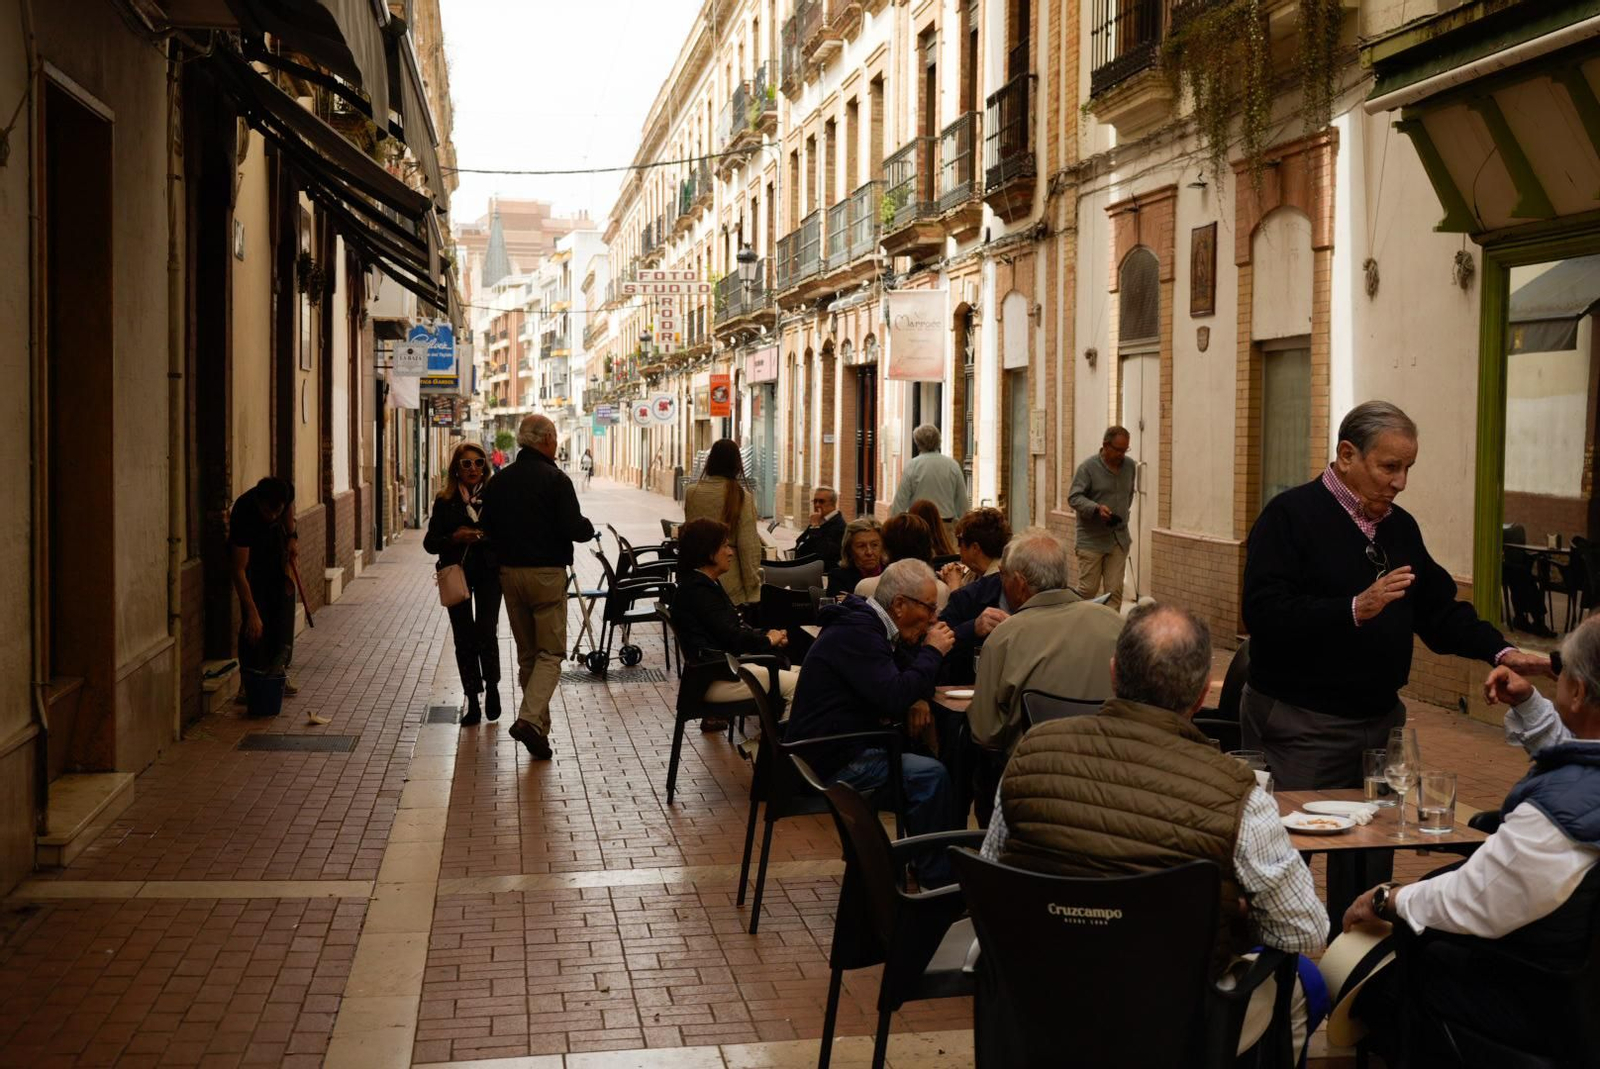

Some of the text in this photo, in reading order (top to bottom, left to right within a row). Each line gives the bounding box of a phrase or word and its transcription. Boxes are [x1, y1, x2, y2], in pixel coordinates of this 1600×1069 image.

[639, 271, 695, 280] FOTO
[624, 284, 710, 293] STUDIO
[661, 297, 673, 353] RODRI
[1047, 902, 1123, 920] Cruzcampo
